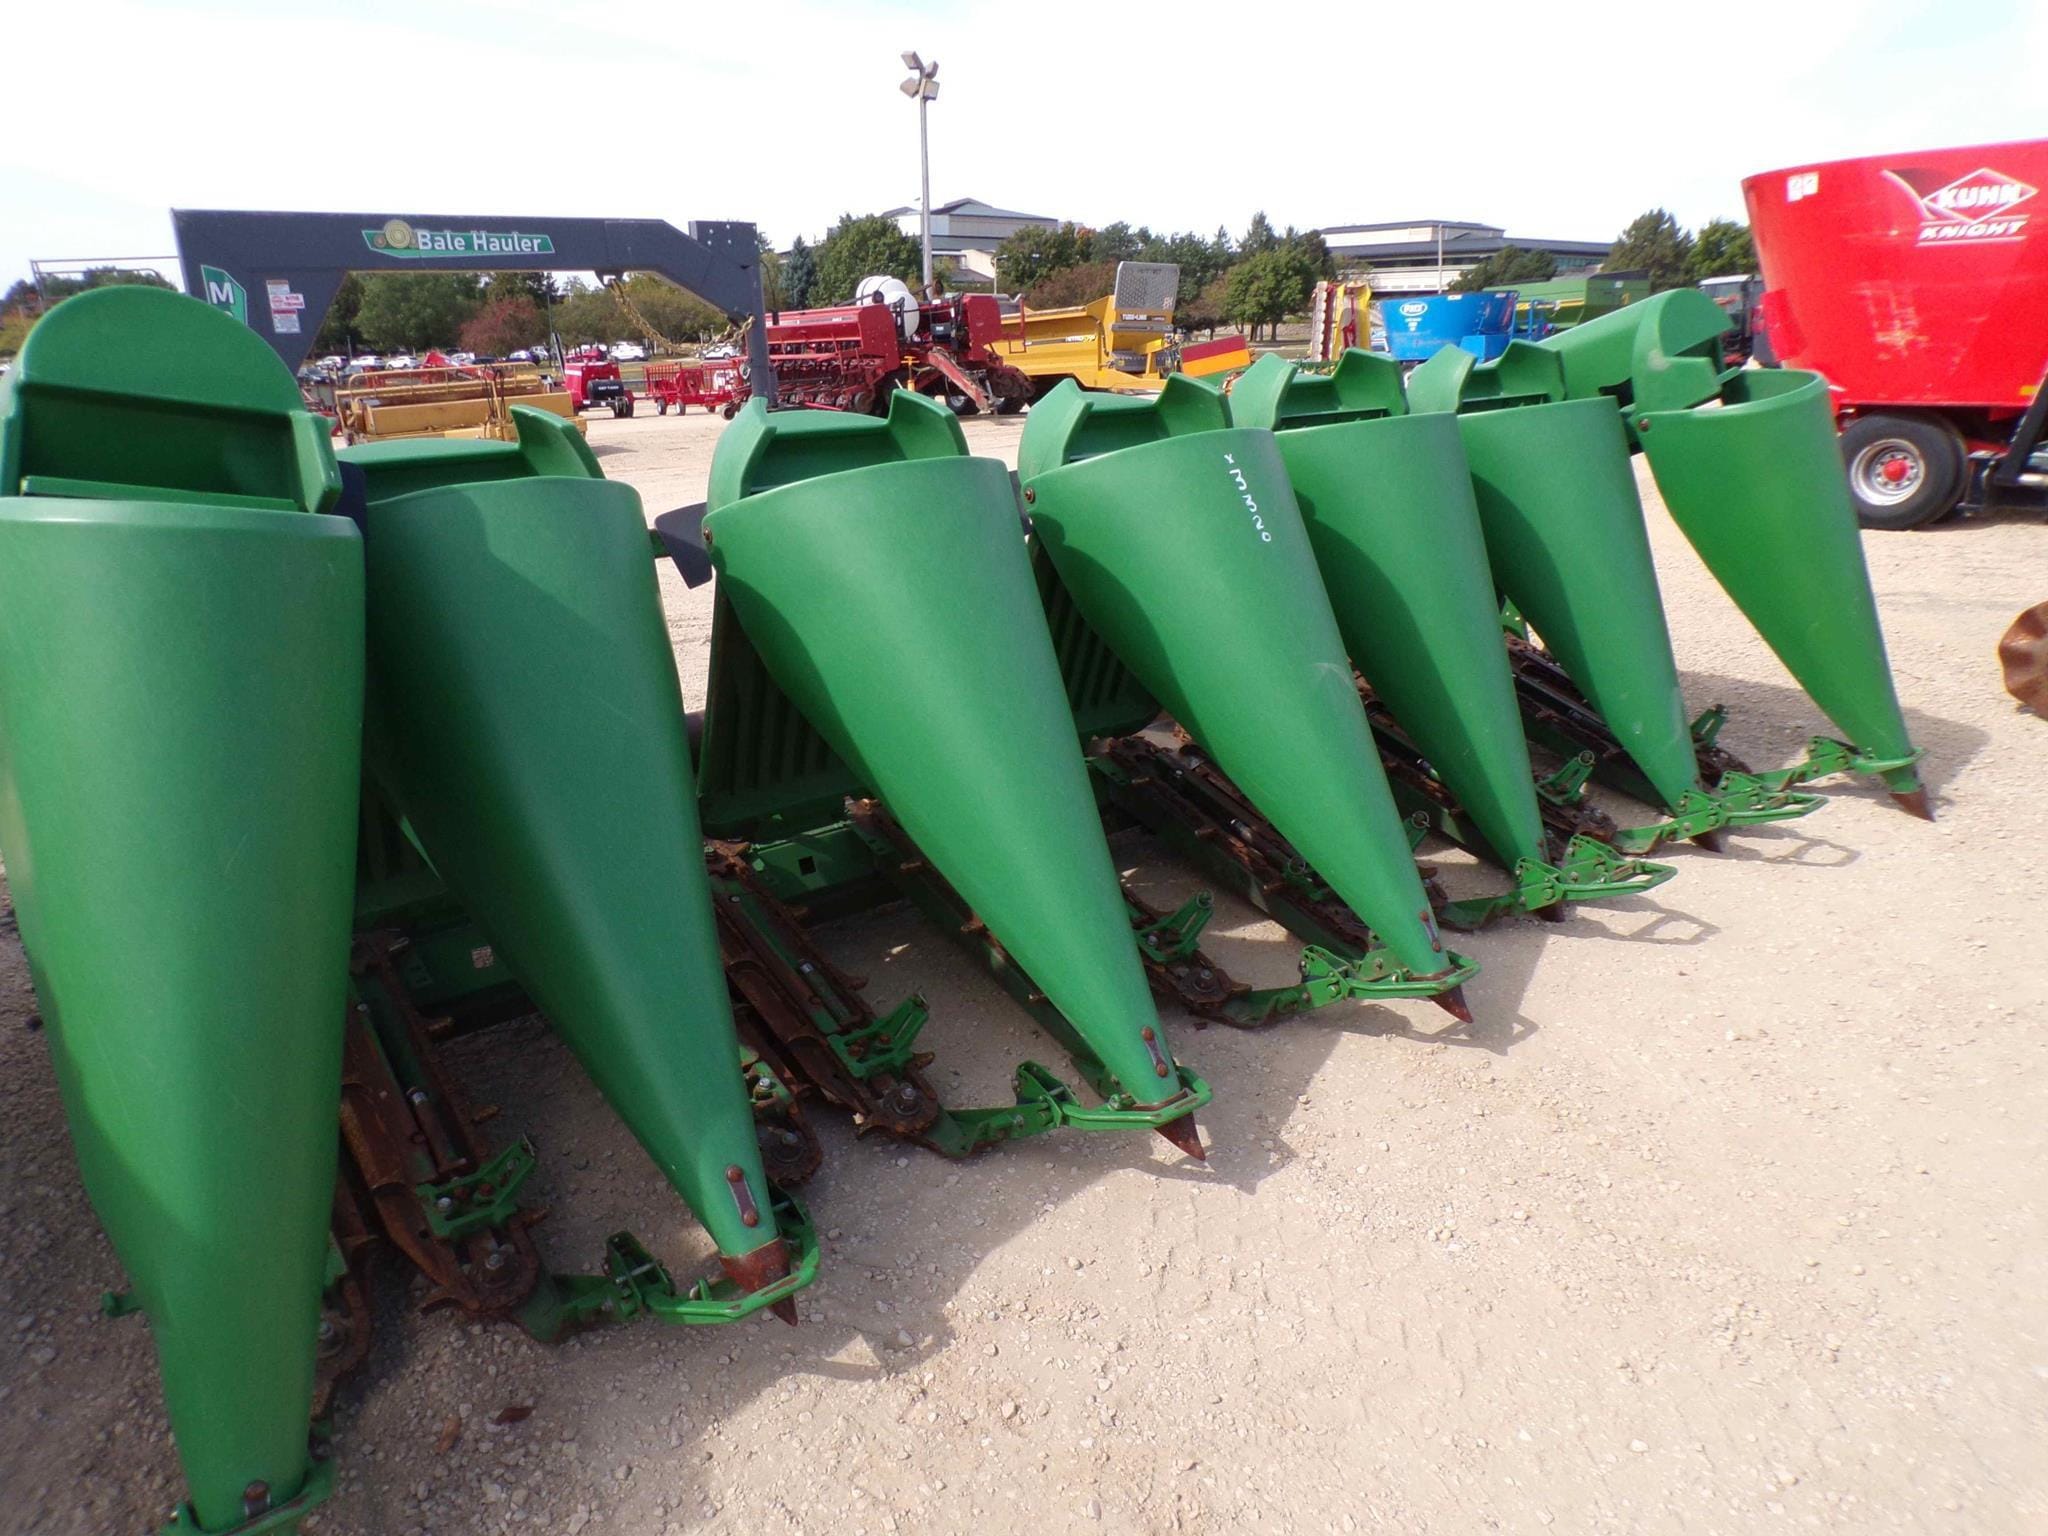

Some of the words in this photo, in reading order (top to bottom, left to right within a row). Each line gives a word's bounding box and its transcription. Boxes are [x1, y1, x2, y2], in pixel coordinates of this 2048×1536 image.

[1936, 184, 2022, 209] KUHN
[416, 230, 466, 251] Bale
[471, 231, 542, 252] Hauler
[1918, 220, 2028, 240] KNIGHT
[208, 281, 235, 305] M
